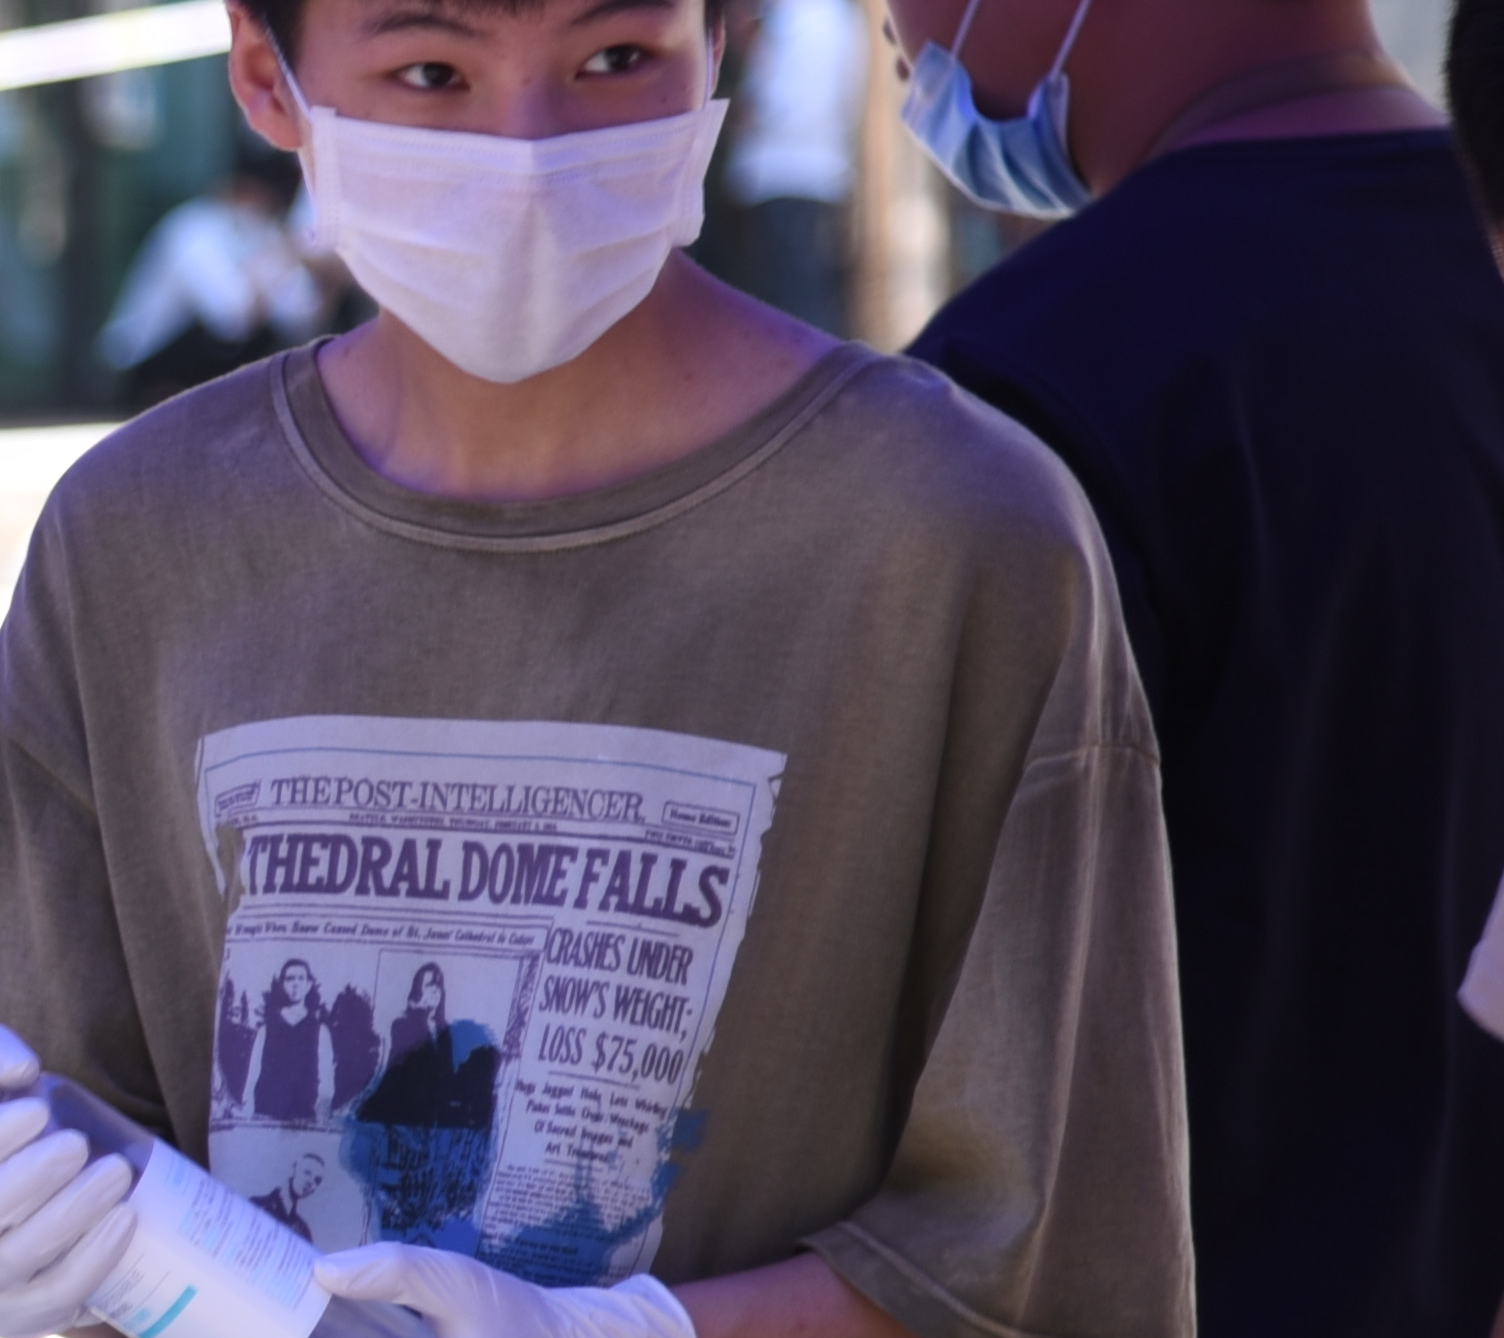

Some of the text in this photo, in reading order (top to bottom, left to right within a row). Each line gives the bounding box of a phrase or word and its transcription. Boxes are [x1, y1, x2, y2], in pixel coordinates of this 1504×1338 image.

[270, 776, 332, 808] THE
[247, 832, 731, 929] THEDRAL DOME FALLS
[545, 926, 694, 986] CRASHES UNDER
[538, 974, 611, 1021] SNOW'S
[538, 1022, 685, 1085] LOSS $75,000
